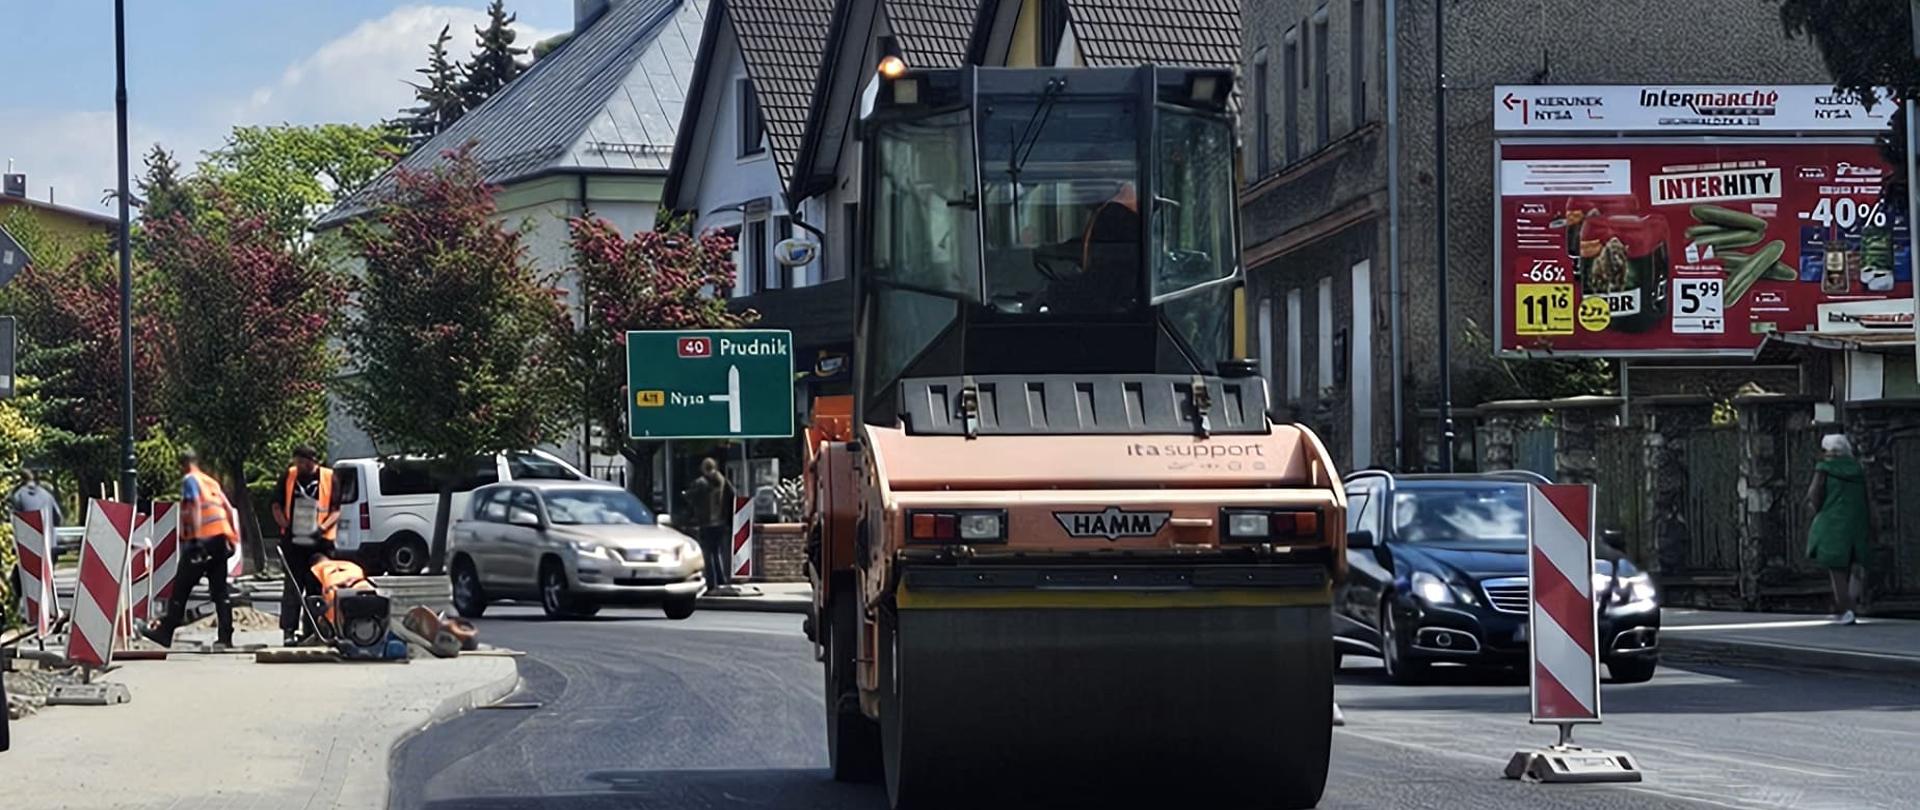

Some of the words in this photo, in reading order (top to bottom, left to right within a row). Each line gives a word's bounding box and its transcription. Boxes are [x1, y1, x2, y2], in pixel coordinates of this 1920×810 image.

[1659, 172, 1774, 200] INTERHITY
[1798, 197, 1887, 229] -40%
[1522, 263, 1566, 282] -66%
[1603, 295, 1635, 312] BR
[685, 340, 704, 354] 40
[720, 338, 787, 356] Prudnik
[670, 391, 704, 407] Nysa
[1165, 444, 1264, 458] support
[1074, 515, 1152, 534] HAMM
